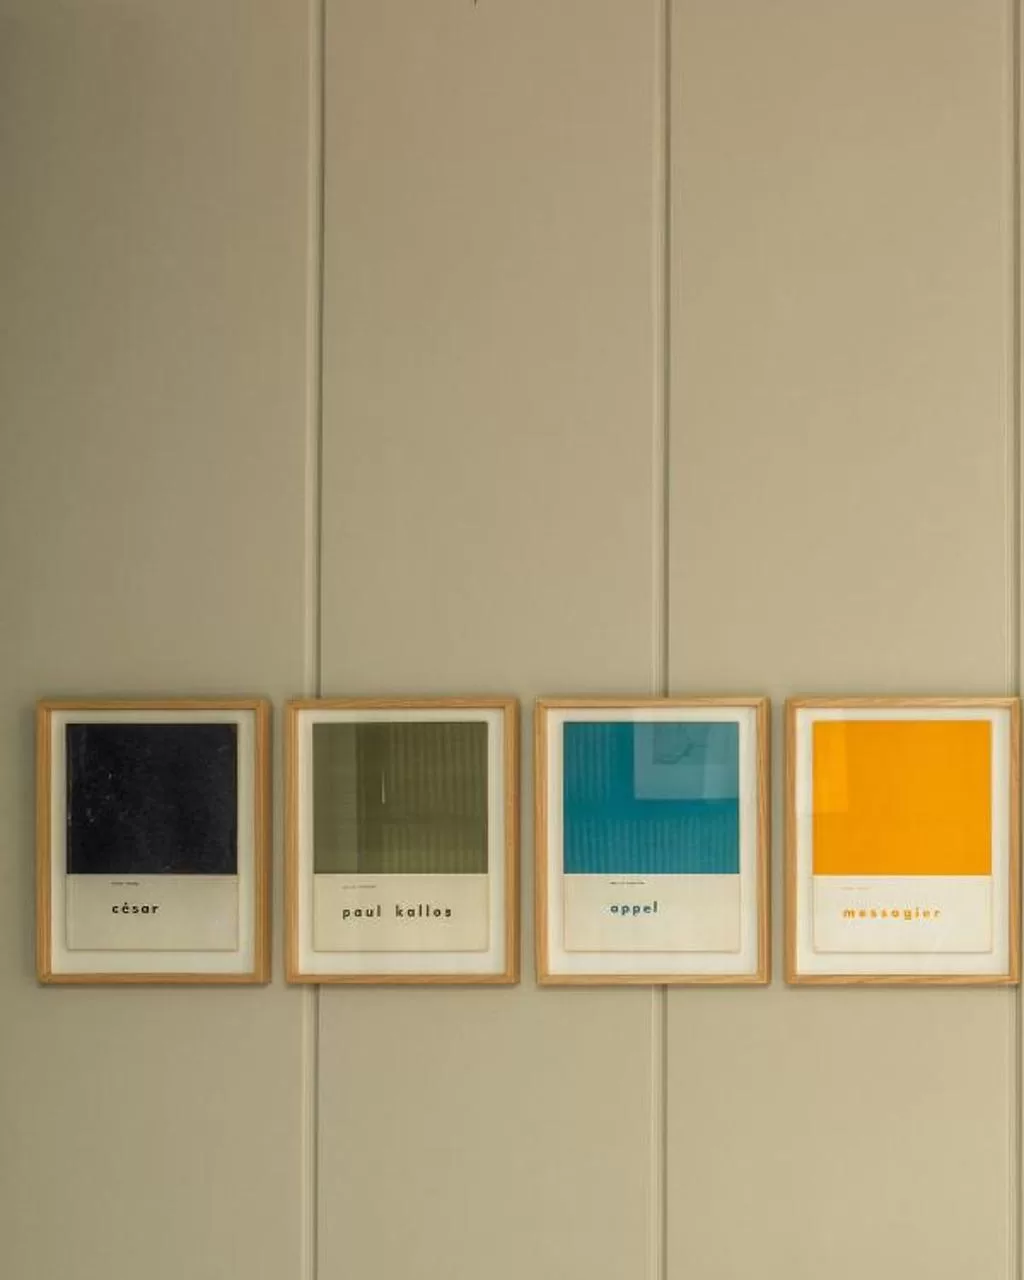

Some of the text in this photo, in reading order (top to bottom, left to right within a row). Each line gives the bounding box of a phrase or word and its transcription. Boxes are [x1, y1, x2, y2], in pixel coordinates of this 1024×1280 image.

[111, 901, 160, 914] césar
[342, 904, 451, 920] paul kallos
[611, 900, 658, 916] appel
[843, 906, 941, 920] messagier
